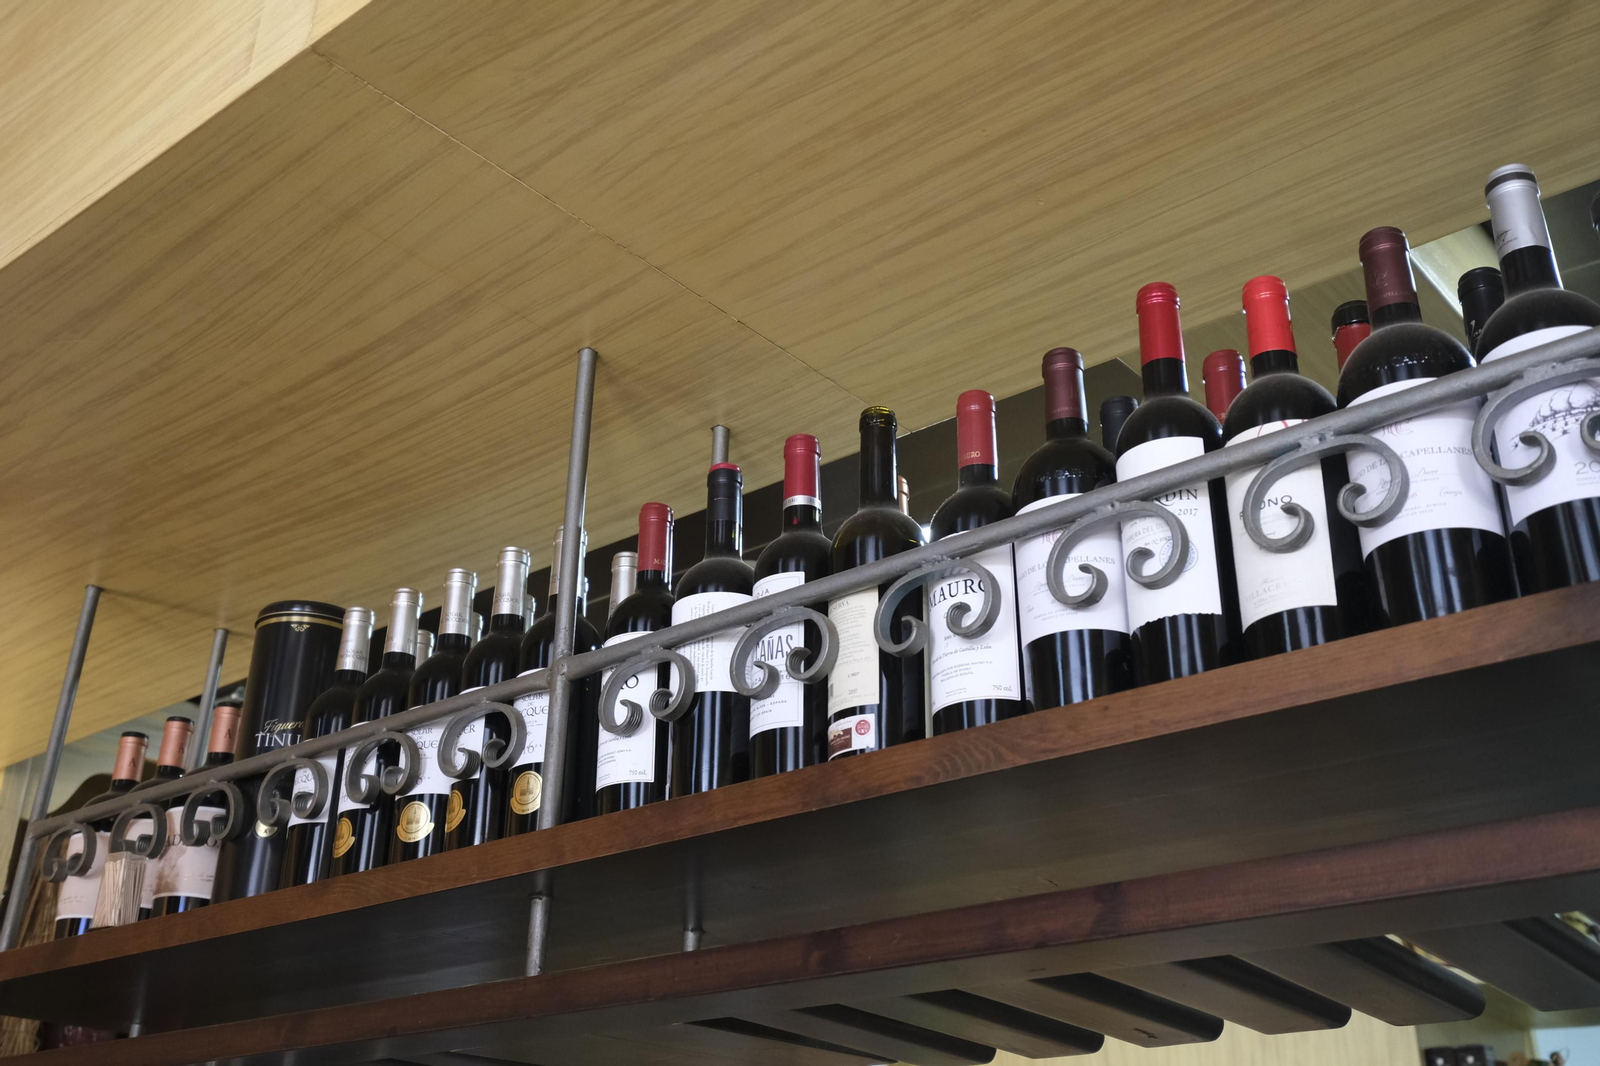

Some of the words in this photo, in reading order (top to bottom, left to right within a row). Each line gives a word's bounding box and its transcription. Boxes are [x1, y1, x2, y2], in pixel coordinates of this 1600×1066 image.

[1177, 508, 1199, 517] 2017
[224, 728, 232, 739] A
[254, 731, 301, 748] TINU
